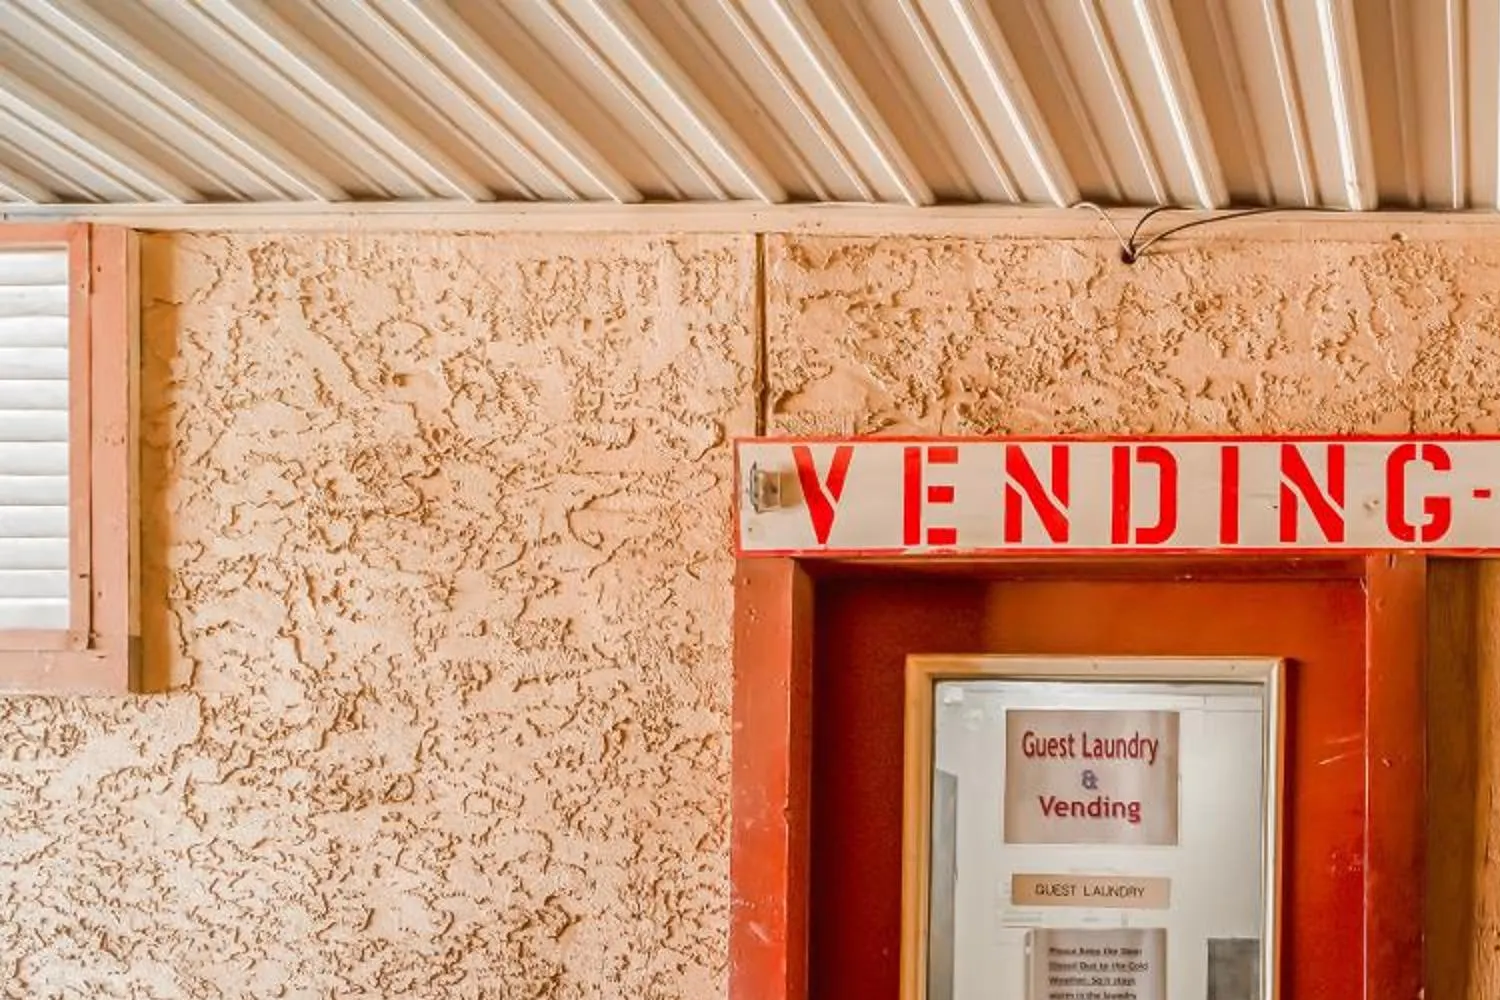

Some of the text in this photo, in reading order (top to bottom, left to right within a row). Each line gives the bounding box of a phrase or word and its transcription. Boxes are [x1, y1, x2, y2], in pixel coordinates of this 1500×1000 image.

[791, 444, 1453, 546] VENDING
[1022, 731, 1159, 765] Guest Laundry
[1081, 769, 1099, 790] &
[1039, 796, 1141, 823] Vending
[1035, 883, 1145, 898] GUEST LAUNDRY
